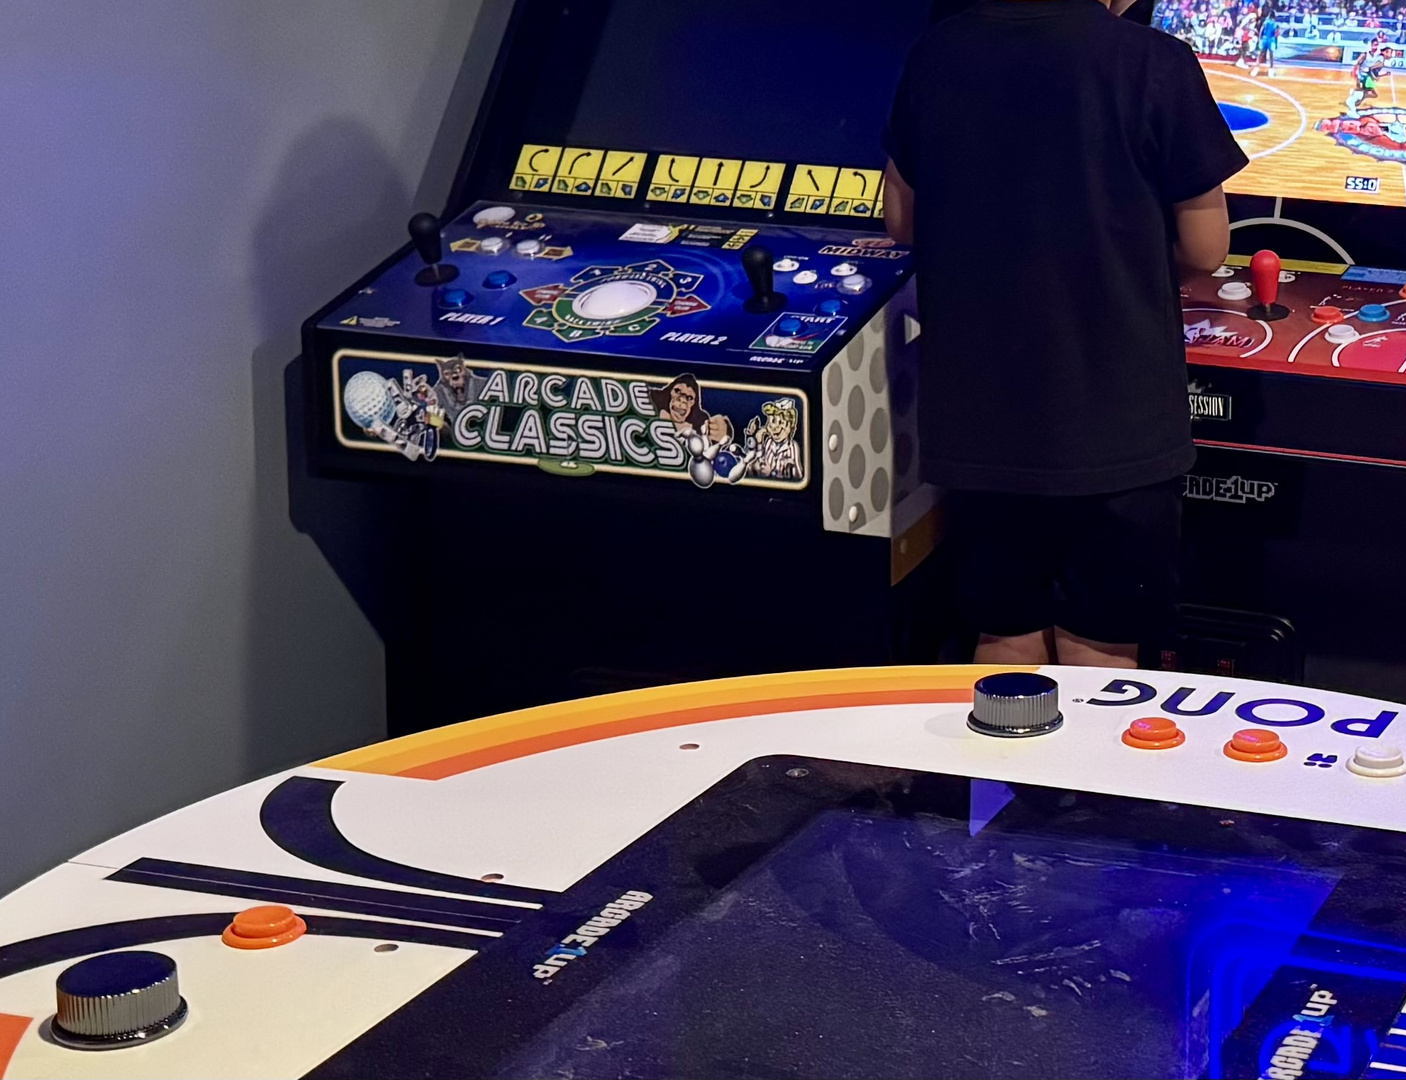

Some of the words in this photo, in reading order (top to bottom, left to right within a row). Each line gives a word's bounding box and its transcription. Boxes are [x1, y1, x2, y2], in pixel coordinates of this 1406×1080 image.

[818, 245, 910, 259] MIDWAY
[439, 312, 494, 325] PLAYER
[660, 331, 714, 345] PLAYER
[477, 369, 657, 417] ARCADE
[453, 404, 688, 470] CLASSICS
[1085, 678, 1399, 739] PONG
